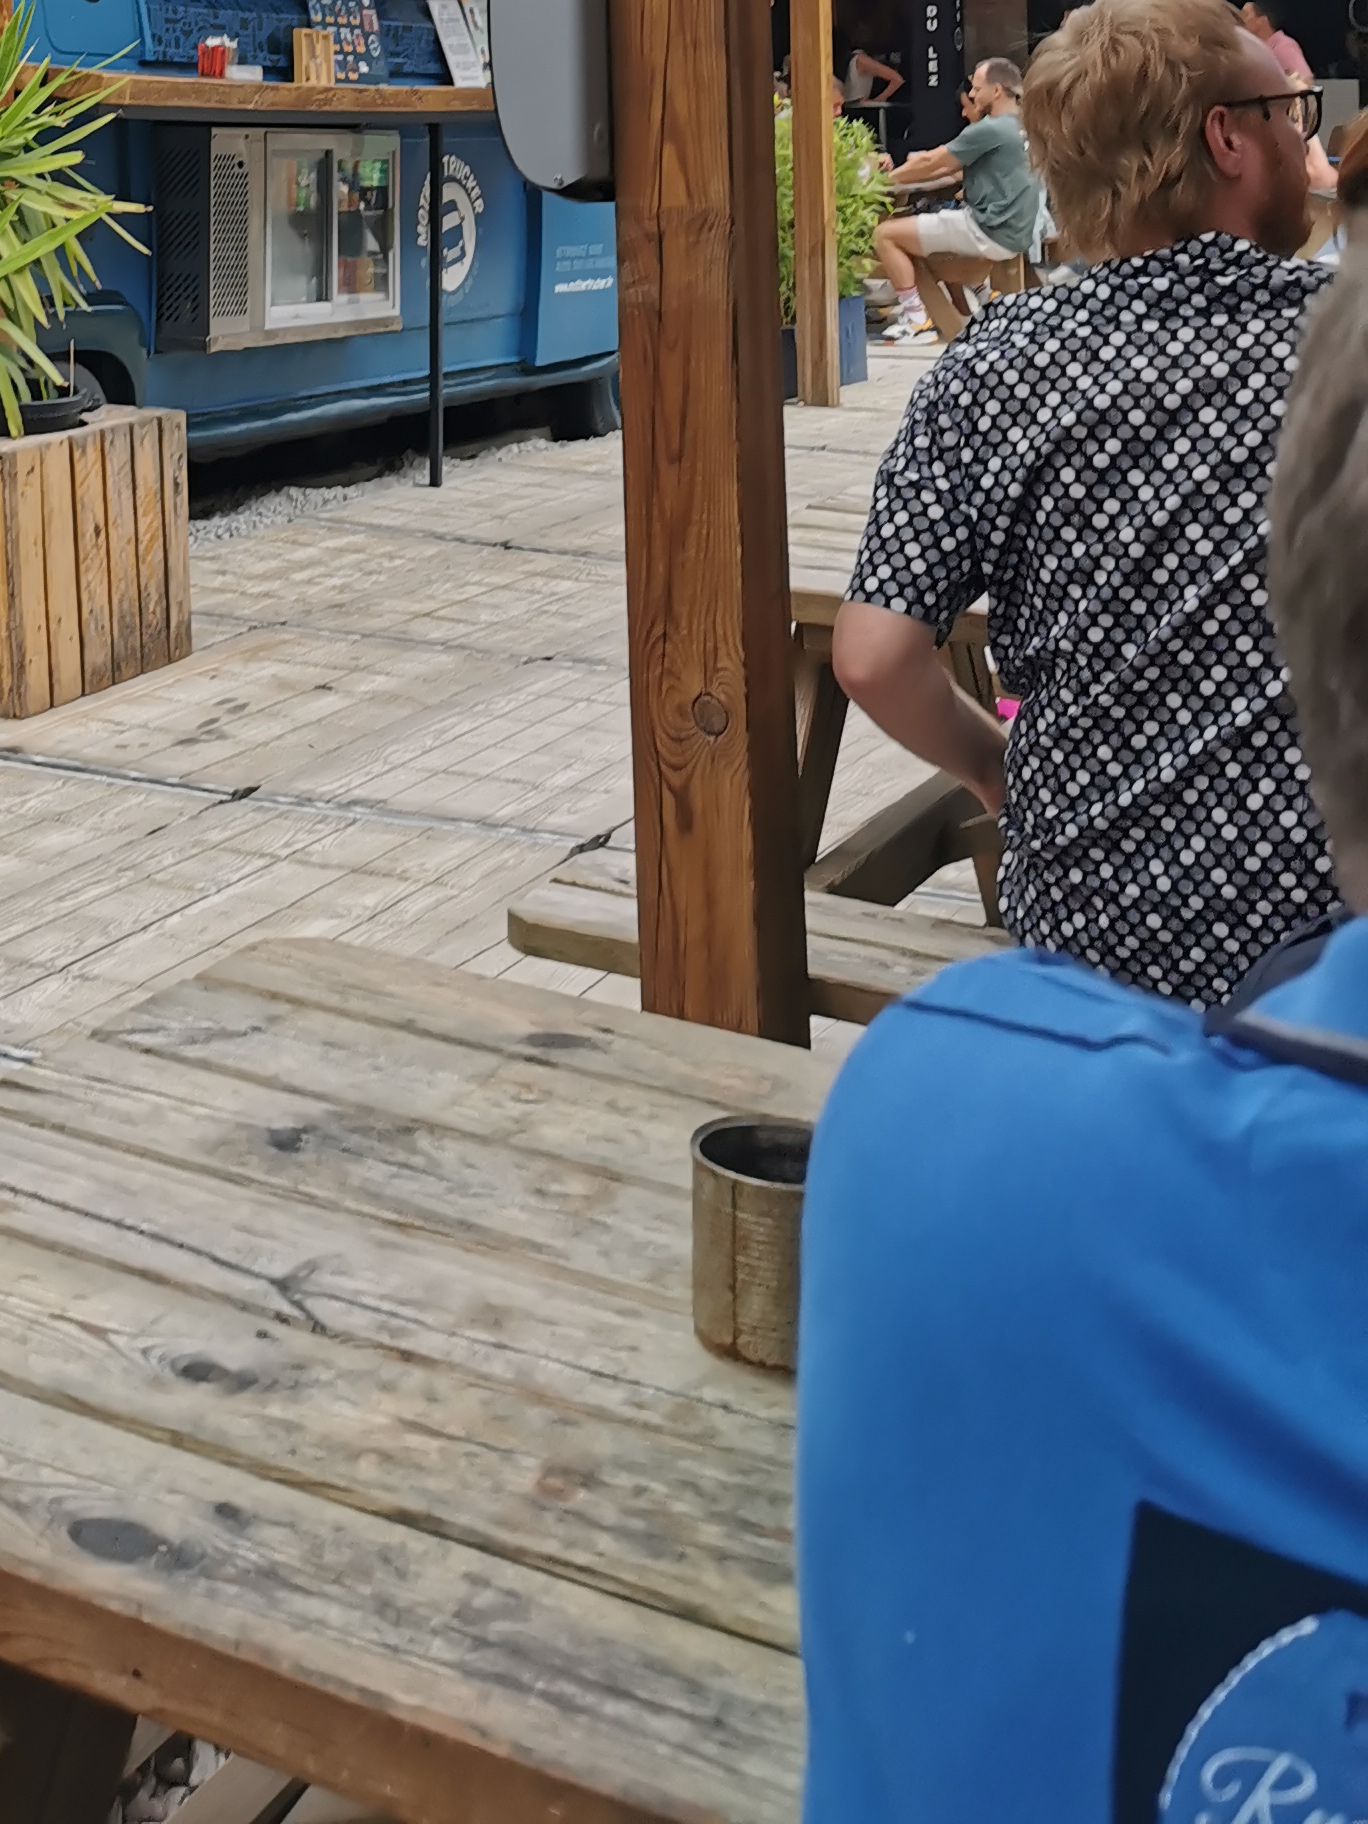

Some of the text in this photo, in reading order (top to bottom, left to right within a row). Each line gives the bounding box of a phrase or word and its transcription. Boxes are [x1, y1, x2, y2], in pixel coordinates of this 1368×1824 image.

[926, 4, 938, 32] DU
[927, 45, 939, 87] LEZ
[442, 153, 485, 215] TRUCKER
